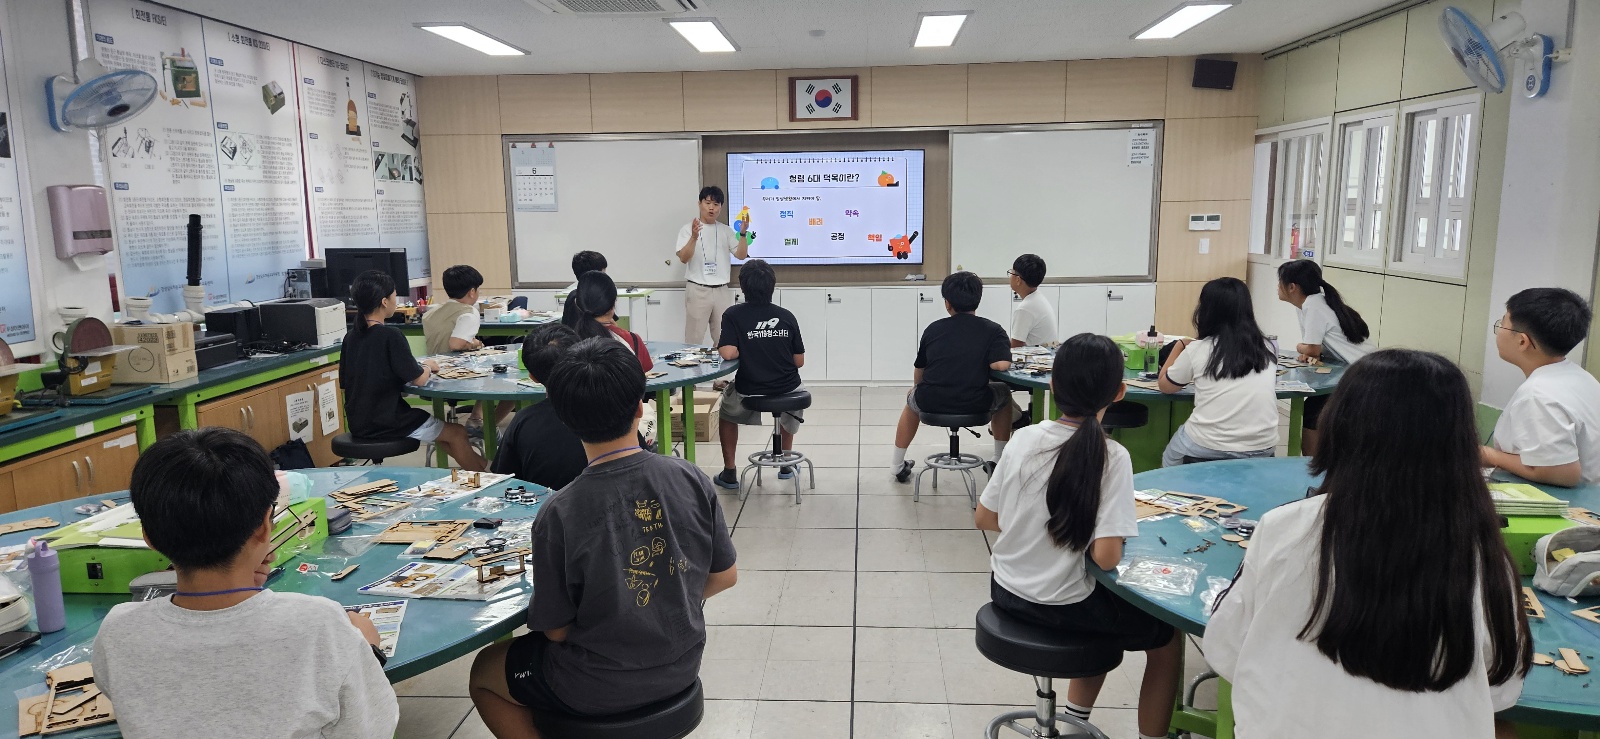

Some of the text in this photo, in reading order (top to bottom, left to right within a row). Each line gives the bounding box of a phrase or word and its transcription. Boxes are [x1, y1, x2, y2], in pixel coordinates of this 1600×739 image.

[789, 173, 860, 183] 청렴 6대 덕목이란?
[780, 210, 794, 218] 정직
[868, 234, 882, 242] 책임
[755, 318, 780, 330] 119
